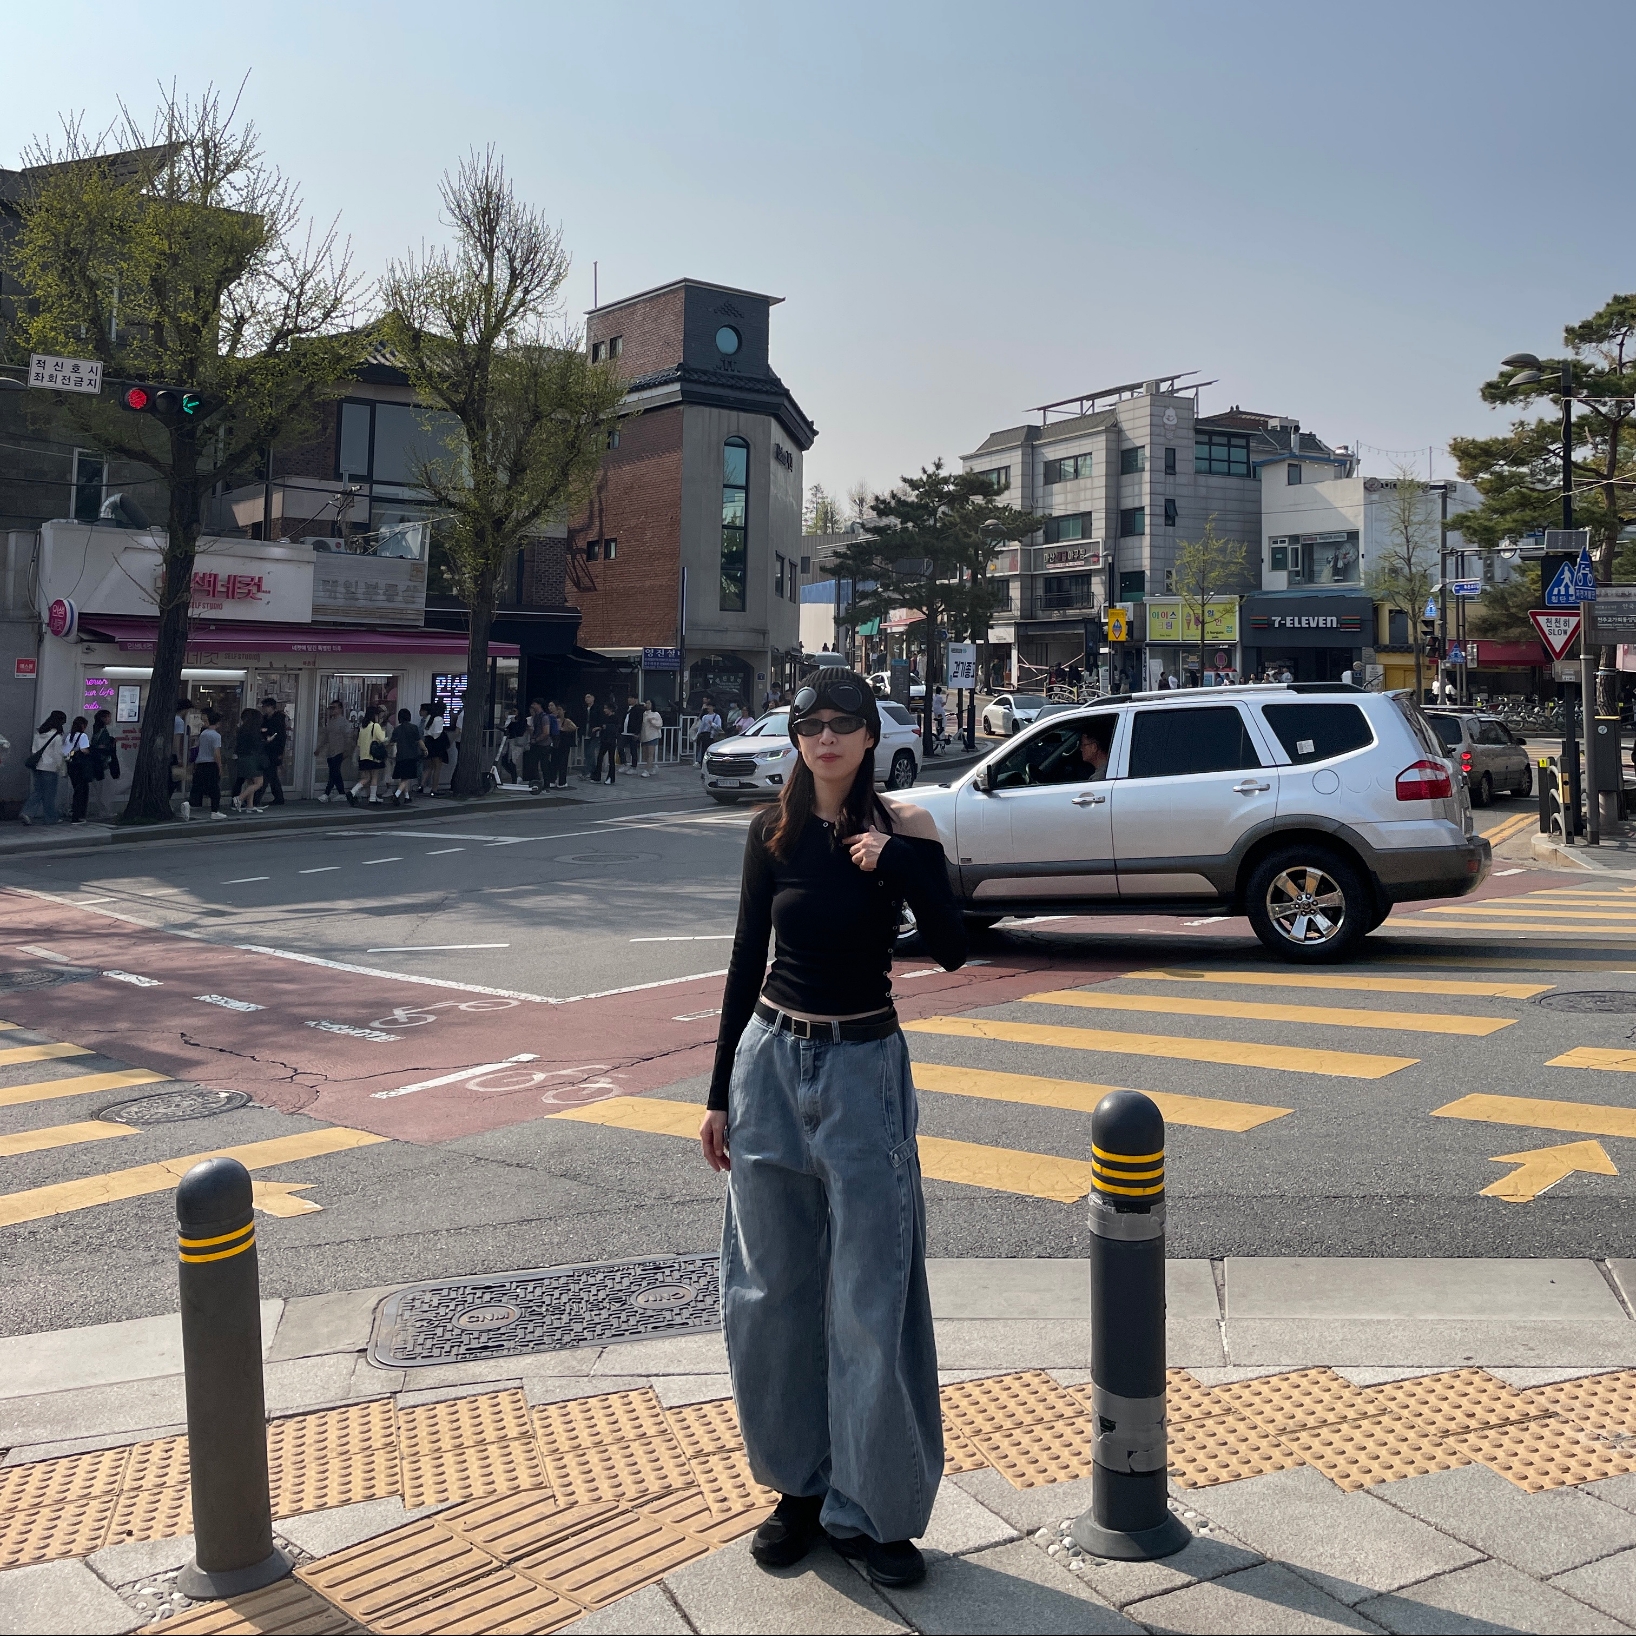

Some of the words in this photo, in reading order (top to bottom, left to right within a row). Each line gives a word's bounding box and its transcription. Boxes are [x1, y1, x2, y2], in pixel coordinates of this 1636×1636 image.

[33, 372, 97, 390] 좌회전금지
[1551, 595, 1581, 603] 횡단보
[1545, 617, 1570, 629] 천천히
[1547, 628, 1568, 636] SLOW
[466, 1311, 510, 1323] CNM
